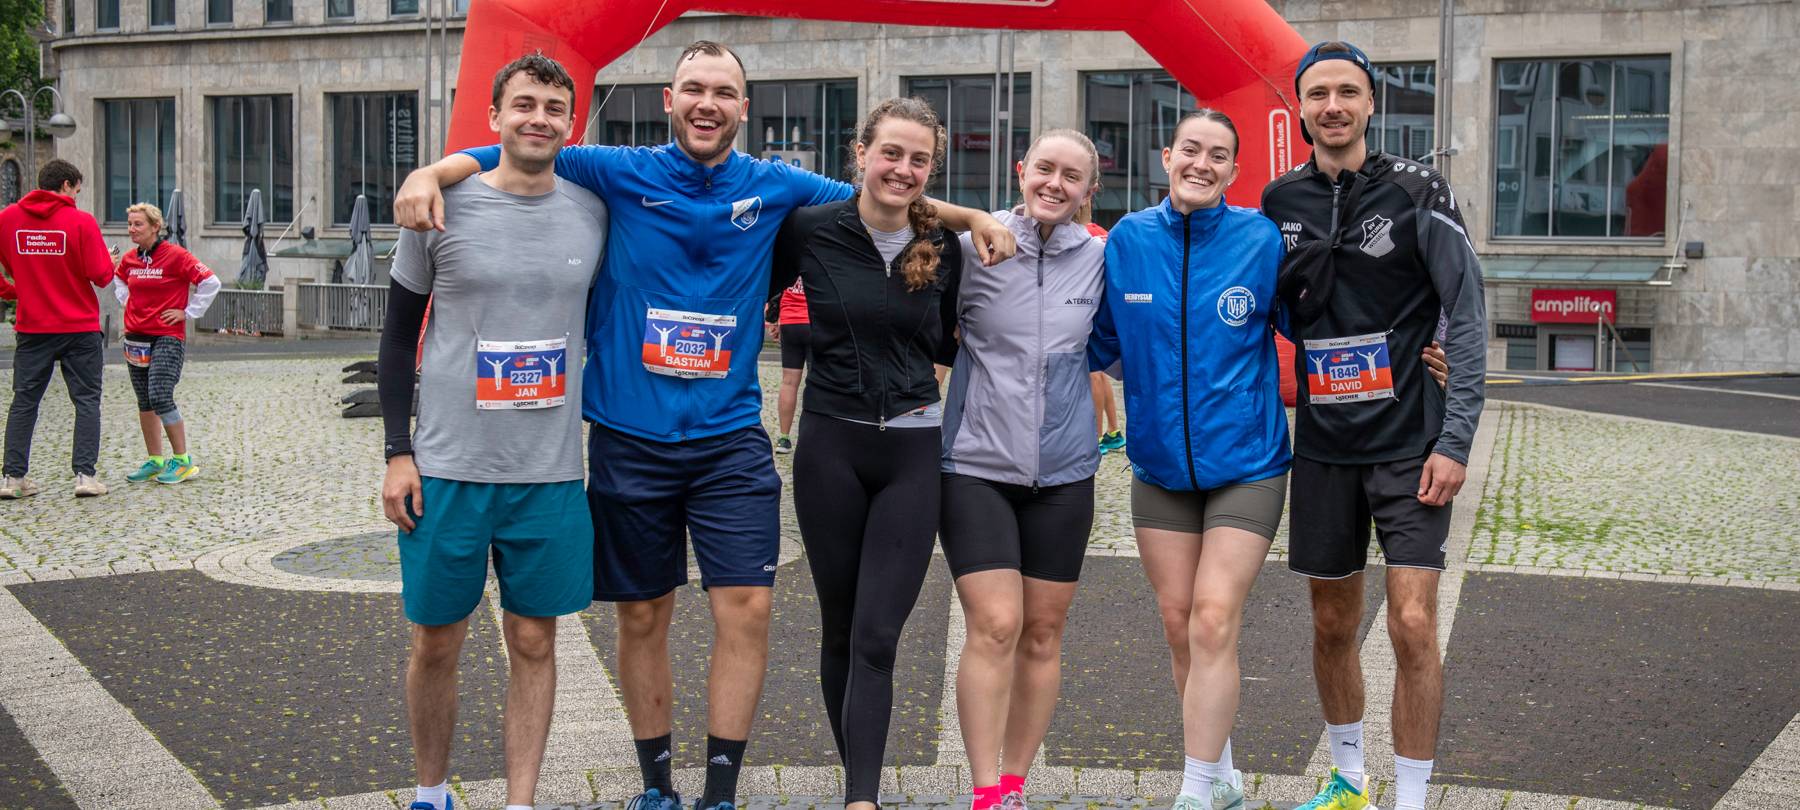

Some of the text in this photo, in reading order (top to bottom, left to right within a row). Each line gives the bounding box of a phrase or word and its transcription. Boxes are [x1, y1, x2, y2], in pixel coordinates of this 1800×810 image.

[1281, 222, 1302, 231] JAKO
[1534, 296, 1612, 316] amplifon
[676, 342, 705, 355] 2032
[665, 355, 711, 368] BASTIAN
[511, 372, 541, 384] 2327
[1330, 366, 1359, 379] 1848
[515, 387, 538, 397] JAN
[1330, 381, 1363, 392] DAVID
